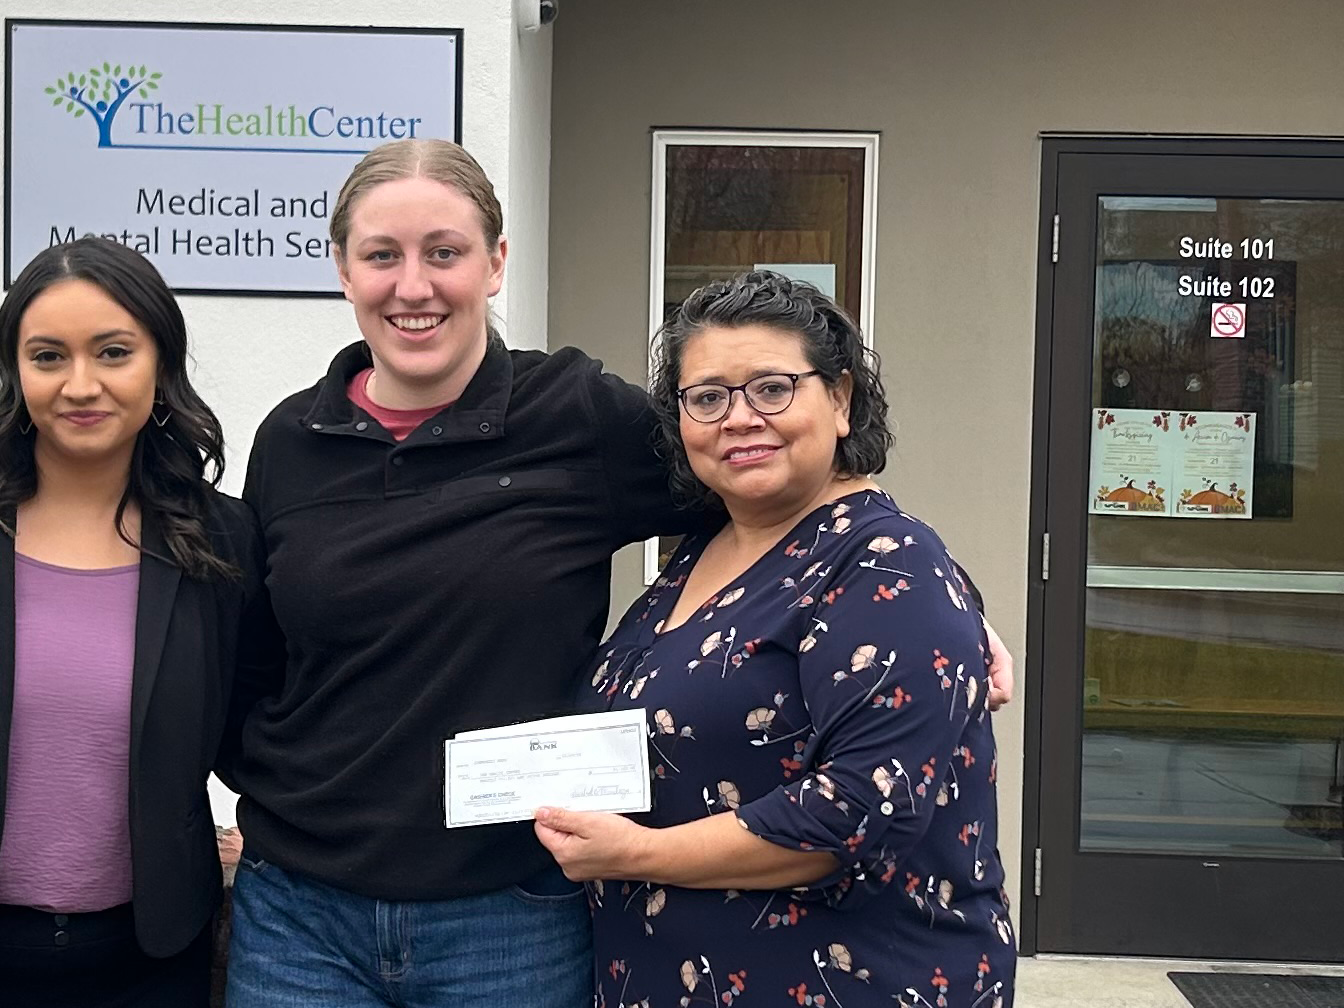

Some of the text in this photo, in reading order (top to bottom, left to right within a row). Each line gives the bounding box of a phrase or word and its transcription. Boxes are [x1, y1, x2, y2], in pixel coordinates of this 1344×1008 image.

[136, 187, 328, 218] Medical and
[48, 226, 159, 254] Mtal
[172, 228, 274, 257] Health
[1179, 236, 1274, 260] Suite 101
[1178, 275, 1275, 298] Suite 102
